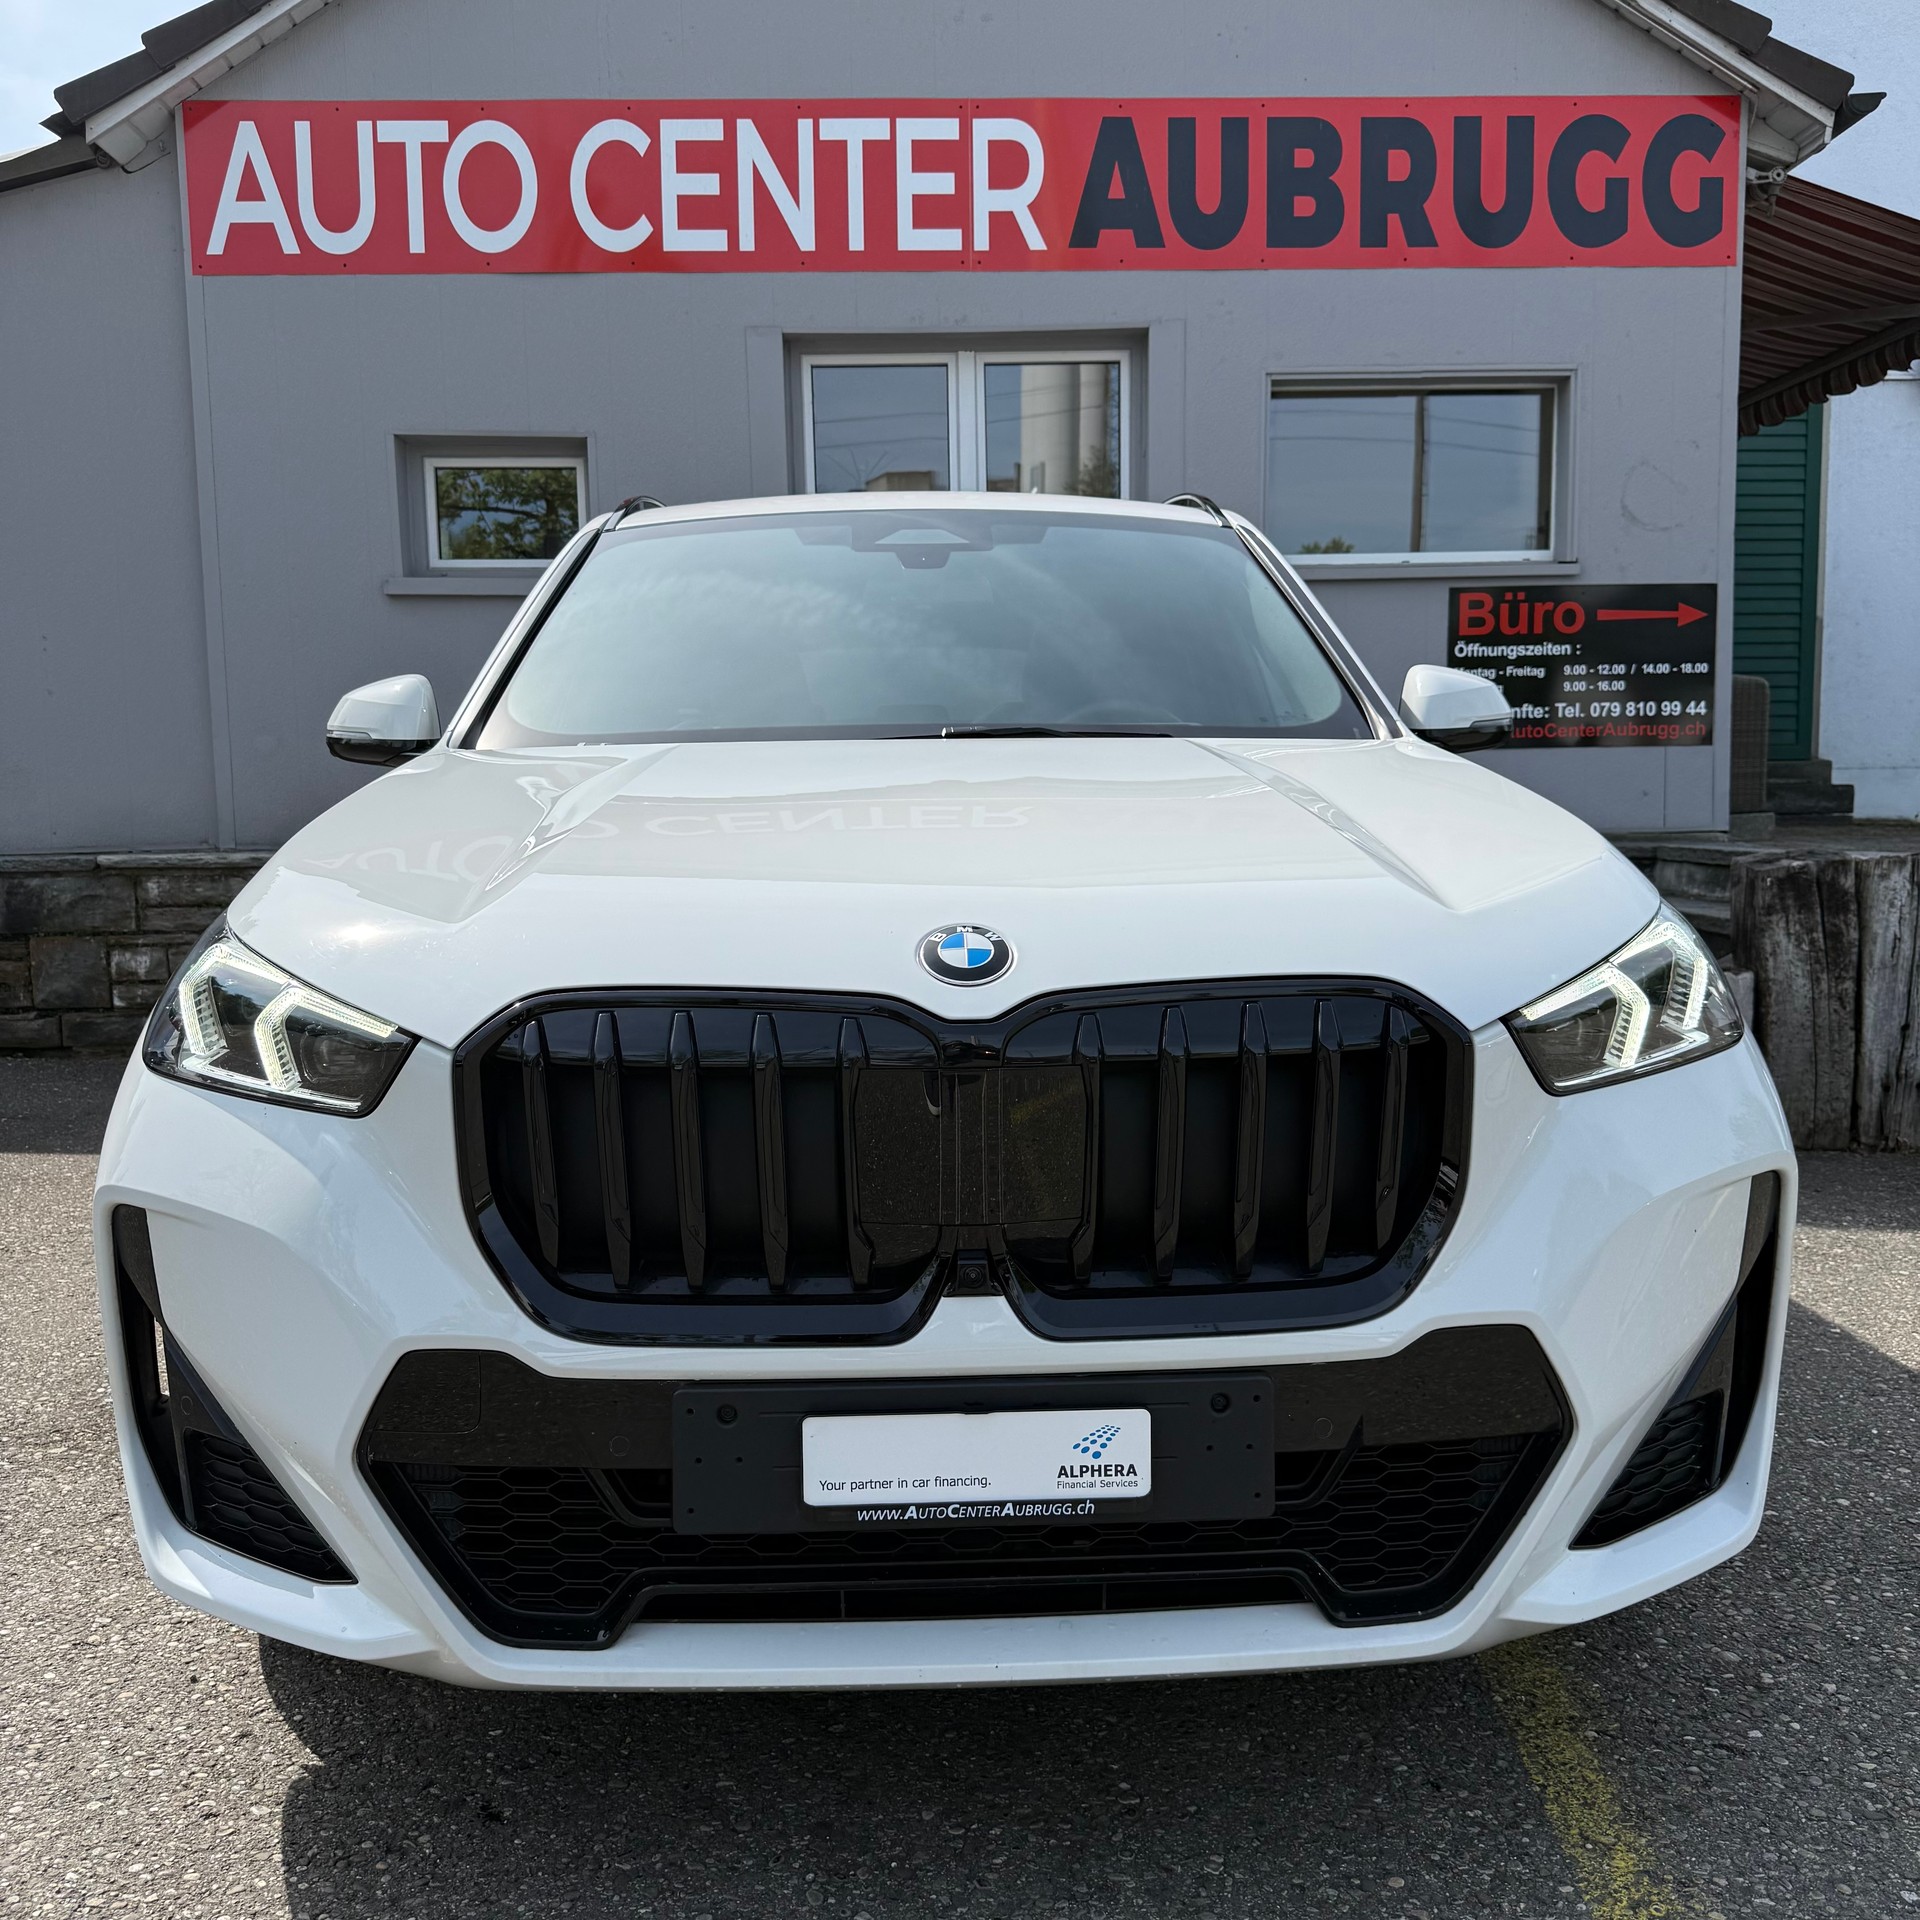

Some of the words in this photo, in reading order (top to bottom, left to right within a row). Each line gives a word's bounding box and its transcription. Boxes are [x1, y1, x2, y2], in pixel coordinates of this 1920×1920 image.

[206, 119, 539, 255] AUTO
[569, 117, 1048, 255] CENTER
[1068, 113, 1728, 251] AUBRUGG
[1458, 591, 1586, 636] Büro
[1454, 640, 1571, 660] Öffnungszeiten
[1456, 666, 1496, 680] ntag
[1506, 666, 1546, 678] Freitag
[1563, 665, 1587, 676] 9.00
[1597, 664, 1626, 675] 12.00
[1641, 663, 1671, 674] 14.00
[1680, 662, 1709, 674] 18.00
[1563, 682, 1587, 692] 9.00
[1597, 681, 1626, 692] 16.00
[1555, 702, 1585, 718] Tel.
[1590, 702, 1621, 717] 079
[1625, 701, 1657, 717] 810
[1661, 701, 1682, 716] 99
[1685, 700, 1708, 716] 44
[929, 926, 1002, 942] BMW
[1057, 1464, 1138, 1478] ALPHERA
[819, 1480, 846, 1491] Your
[850, 1479, 894, 1492] partner
[898, 1477, 908, 1489] in
[912, 1479, 931, 1488] car
[934, 1475, 991, 1490] financing.
[1057, 1480, 1097, 1489] Financial
[1100, 1479, 1138, 1488] Services
